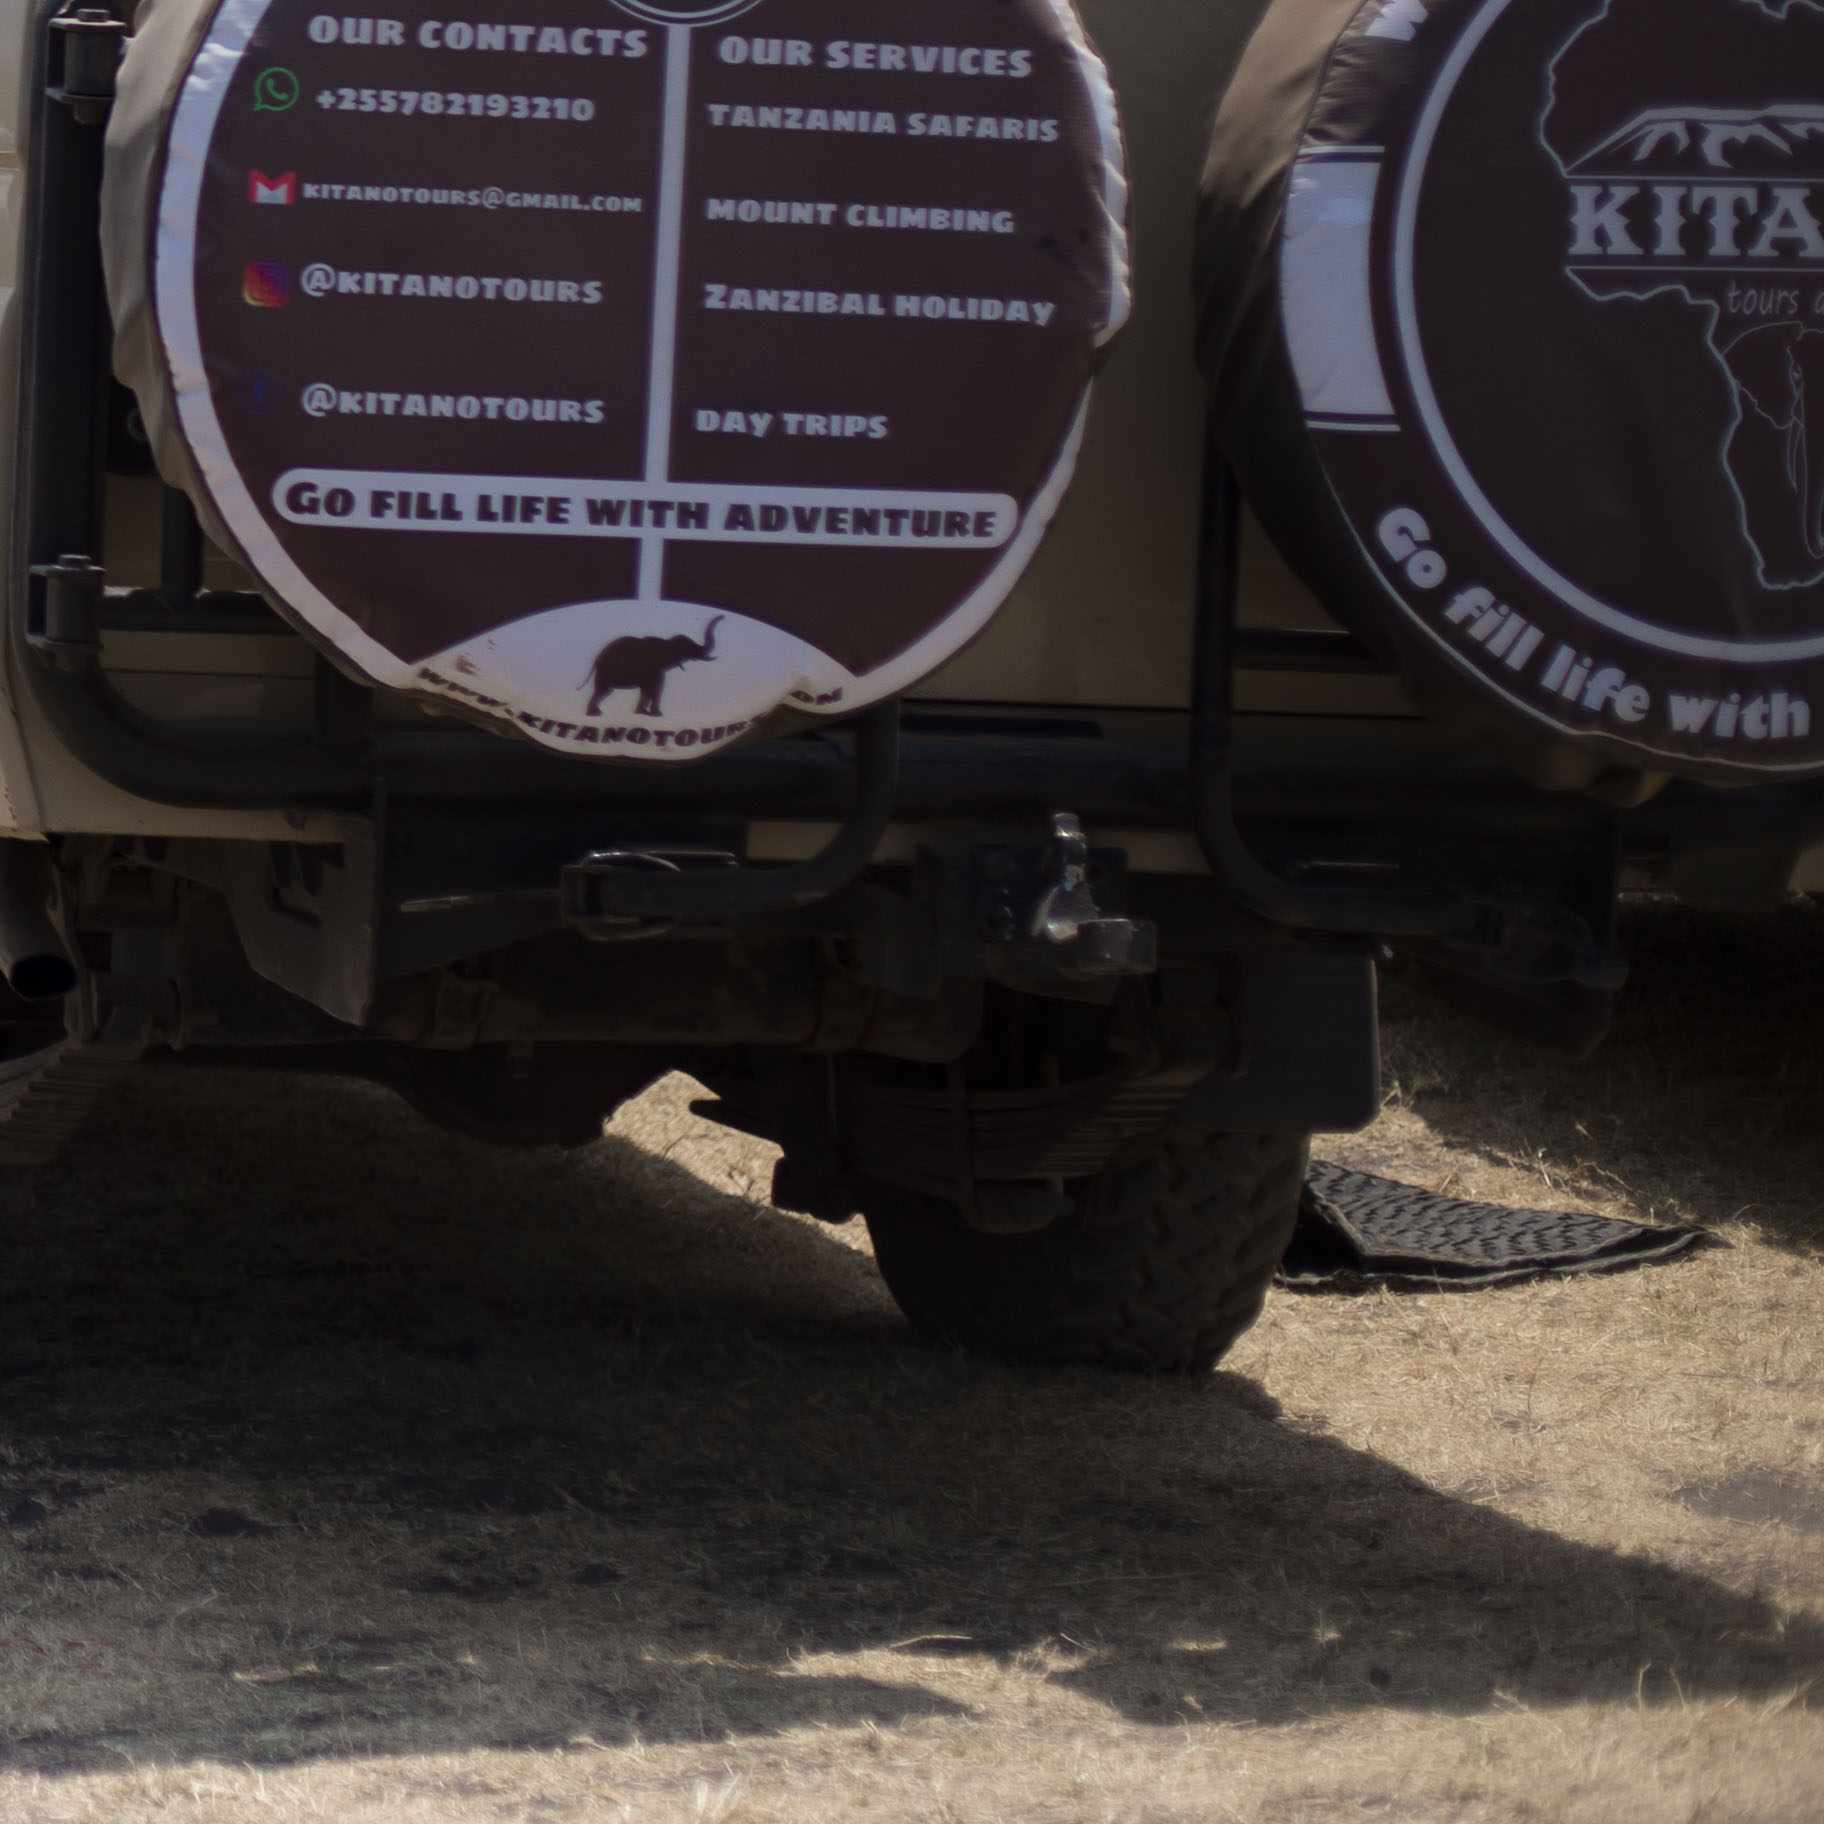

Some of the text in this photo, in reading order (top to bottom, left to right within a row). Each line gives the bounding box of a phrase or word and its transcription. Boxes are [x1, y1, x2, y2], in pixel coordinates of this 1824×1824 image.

[307, 14, 649, 58] OUR CONTACTS
[719, 36, 1033, 77] OUR SERVICES
[316, 87, 595, 121] +255782193210
[707, 103, 1059, 142] TANZANIA SAFARIS
[302, 182, 643, 212] KITANOTOURS@GMAIL.COM
[706, 198, 1016, 233] MOUNT CLIMBING
[300, 262, 603, 304] @KITANOTOURS
[1728, 280, 1800, 314] tours
[704, 283, 1056, 326] ZANZIBAL HOLIDAY
[300, 382, 605, 424] @KITANOTOURS
[695, 409, 888, 439] DAY TRIPS
[285, 481, 998, 538] GO FILL LIFE WITH ADVENTURE
[1378, 507, 1811, 740] Go fill life with
